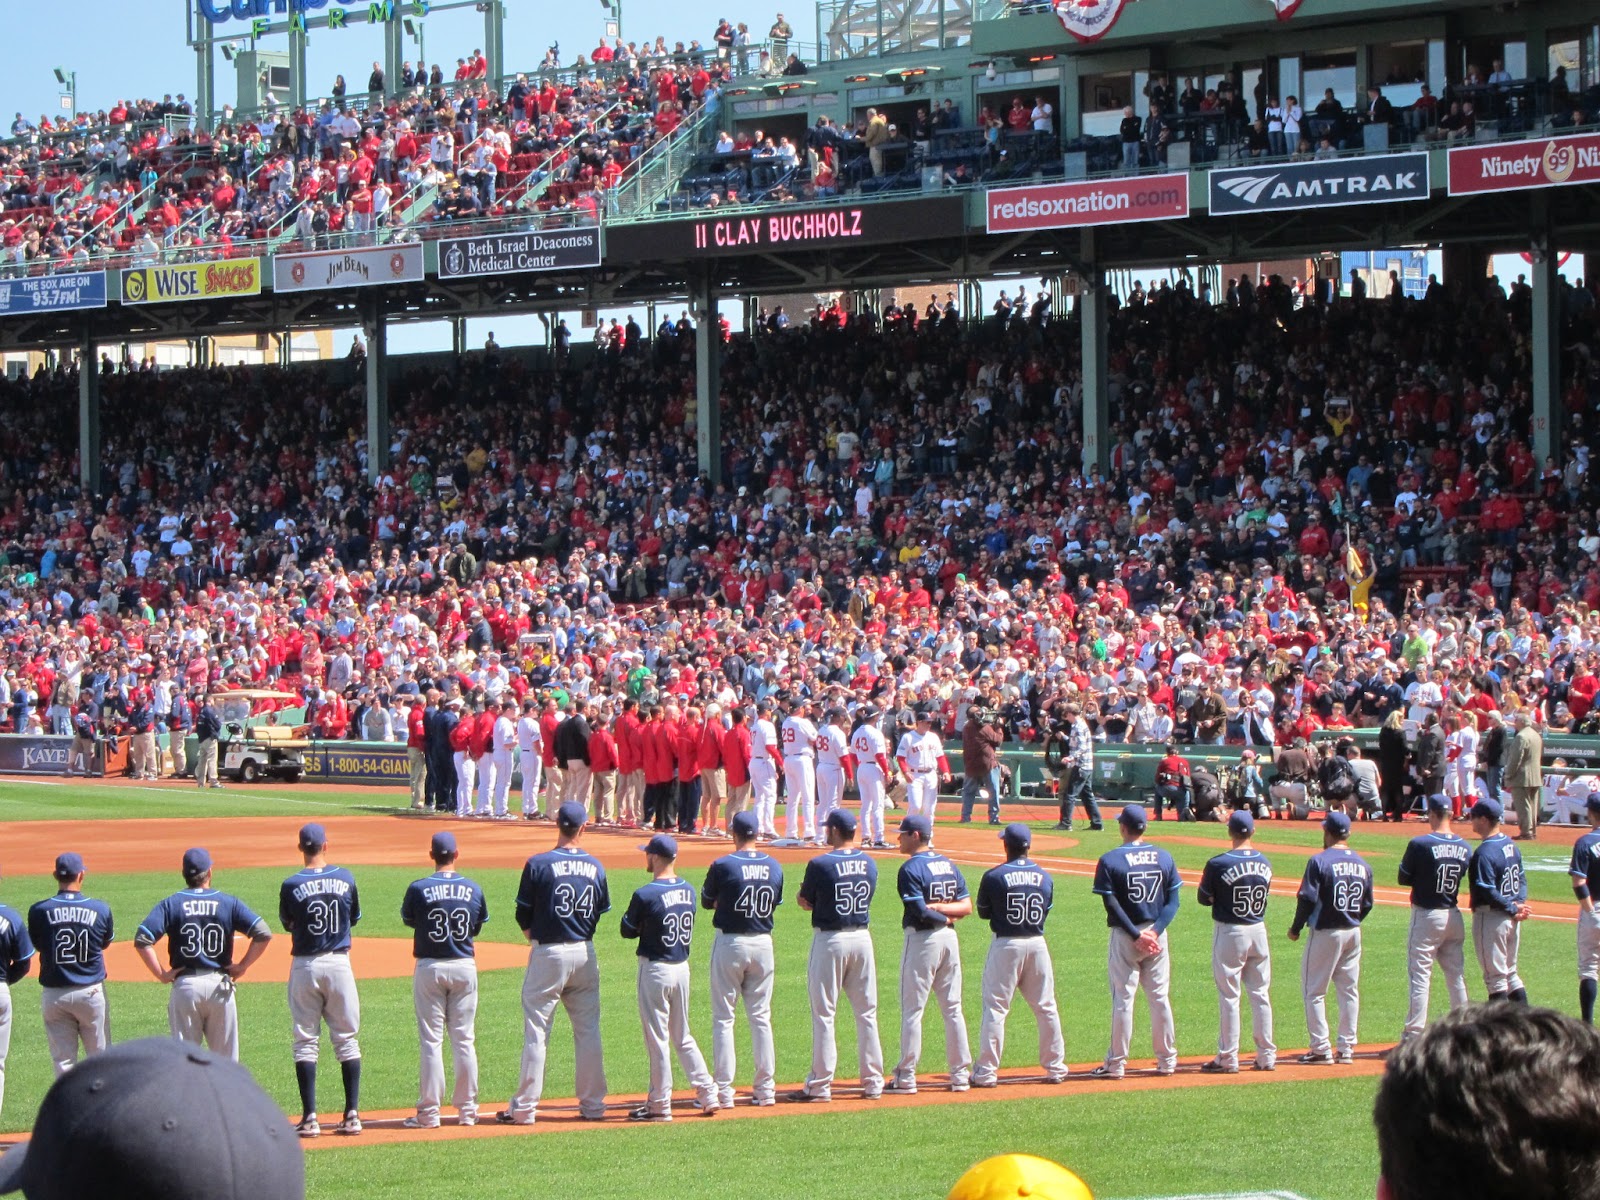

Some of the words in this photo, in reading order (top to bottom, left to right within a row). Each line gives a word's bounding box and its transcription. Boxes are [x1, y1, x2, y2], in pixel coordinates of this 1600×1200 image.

[252, 0, 428, 39] FARMS
[1481, 155, 1541, 177] Ninety
[1548, 147, 1570, 171] 99
[1577, 147, 1600, 168] Ni
[1271, 171, 1416, 199] AMTRAK
[993, 189, 1179, 219] redsoxnation.com
[715, 218, 761, 247] CLAY
[769, 210, 862, 242] BUCHHOLZ
[468, 240, 493, 257] Beth
[498, 236, 528, 254] Israel
[533, 235, 593, 251] Deaconess
[326, 262, 342, 284] JIM
[344, 255, 369, 280] BEAM
[468, 254, 513, 273] Medical
[518, 253, 556, 268] Center
[22, 281, 39, 292] THE
[40, 279, 57, 290] SOX
[60, 278, 76, 289] ARE
[76, 276, 90, 287] ON
[155, 268, 199, 297] WISE
[205, 264, 254, 294] SNACKS
[1065, 279, 1075, 293] 10
[782, 728, 796, 742] 29
[855, 737, 868, 752] 43
[329, 757, 412, 775] 1-800-54-GIAN
[1125, 851, 1158, 867] McGEE
[1431, 844, 1468, 862] BRIGNAC
[551, 860, 597, 880] NIEMANN
[741, 865, 770, 880] DAVIS
[836, 860, 868, 877] LUEKE
[1004, 870, 1044, 887] RODNEY
[1221, 861, 1273, 886] HELLICKSO
[1332, 862, 1366, 880] PERALTA
[1436, 864, 1461, 894] 15
[1500, 863, 1520, 898] 26
[292, 878, 350, 902] BADENHOP
[423, 884, 473, 903] SHIELDS
[834, 880, 871, 916] 52
[930, 880, 957, 904] 55
[1127, 870, 1163, 904] 57
[1333, 880, 1364, 912] 62
[183, 900, 219, 916] SCOTT
[554, 883, 594, 919] 34
[734, 885, 775, 918] 40
[1006, 892, 1044, 925] 56
[1232, 885, 1267, 917] 58
[46, 906, 97, 927] LOBATON
[307, 899, 339, 936] 31
[428, 907, 471, 942] 33
[180, 922, 225, 958] 30
[661, 911, 694, 948] 39
[55, 928, 89, 965] 21
